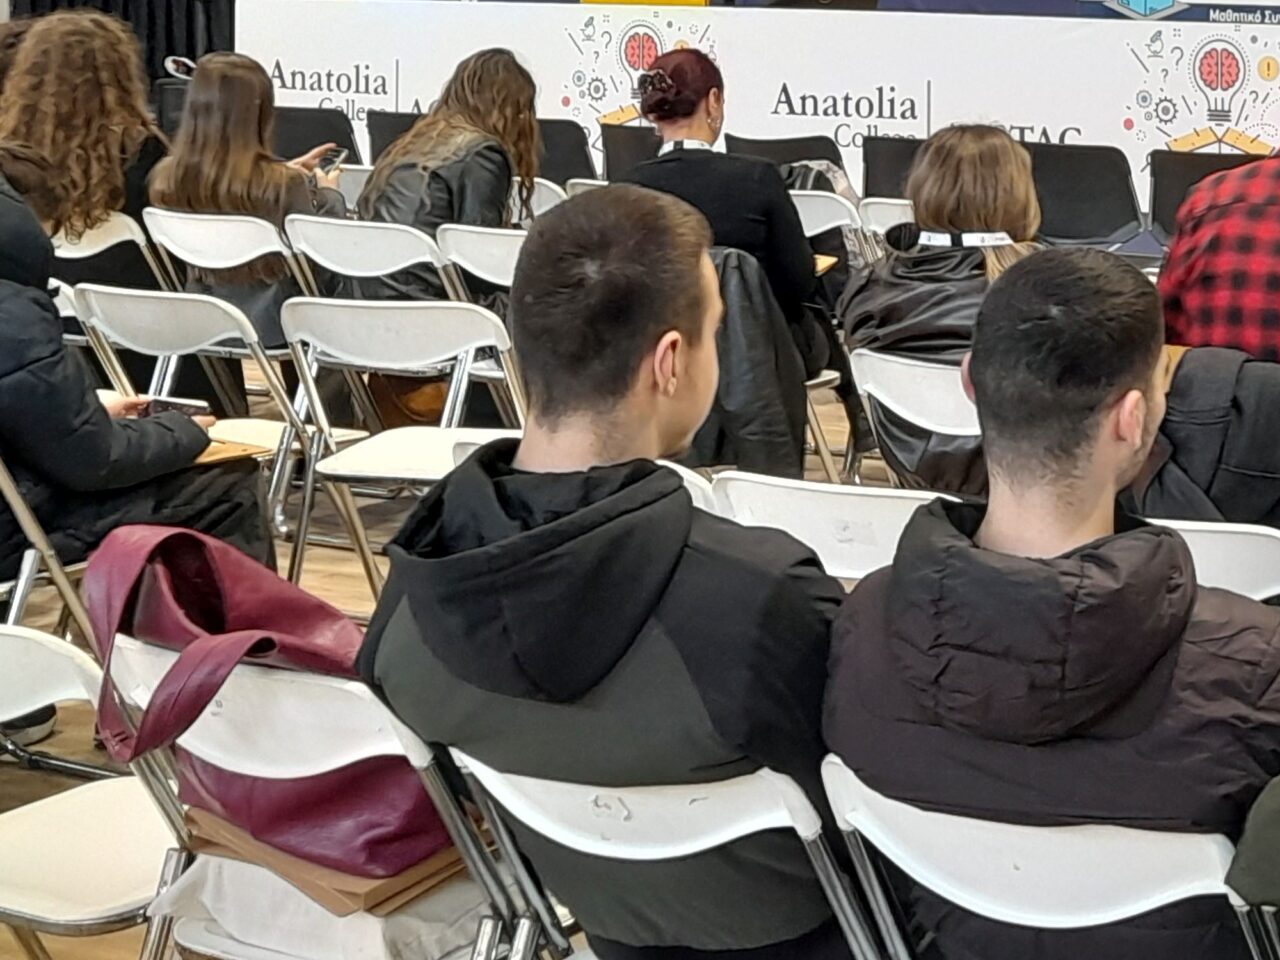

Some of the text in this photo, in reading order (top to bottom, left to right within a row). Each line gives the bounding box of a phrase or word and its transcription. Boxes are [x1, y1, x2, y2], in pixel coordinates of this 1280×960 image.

[1209, 8, 1262, 23] Μαθητικό
[271, 58, 388, 96] Anatolia
[771, 82, 918, 121] Anatolia
